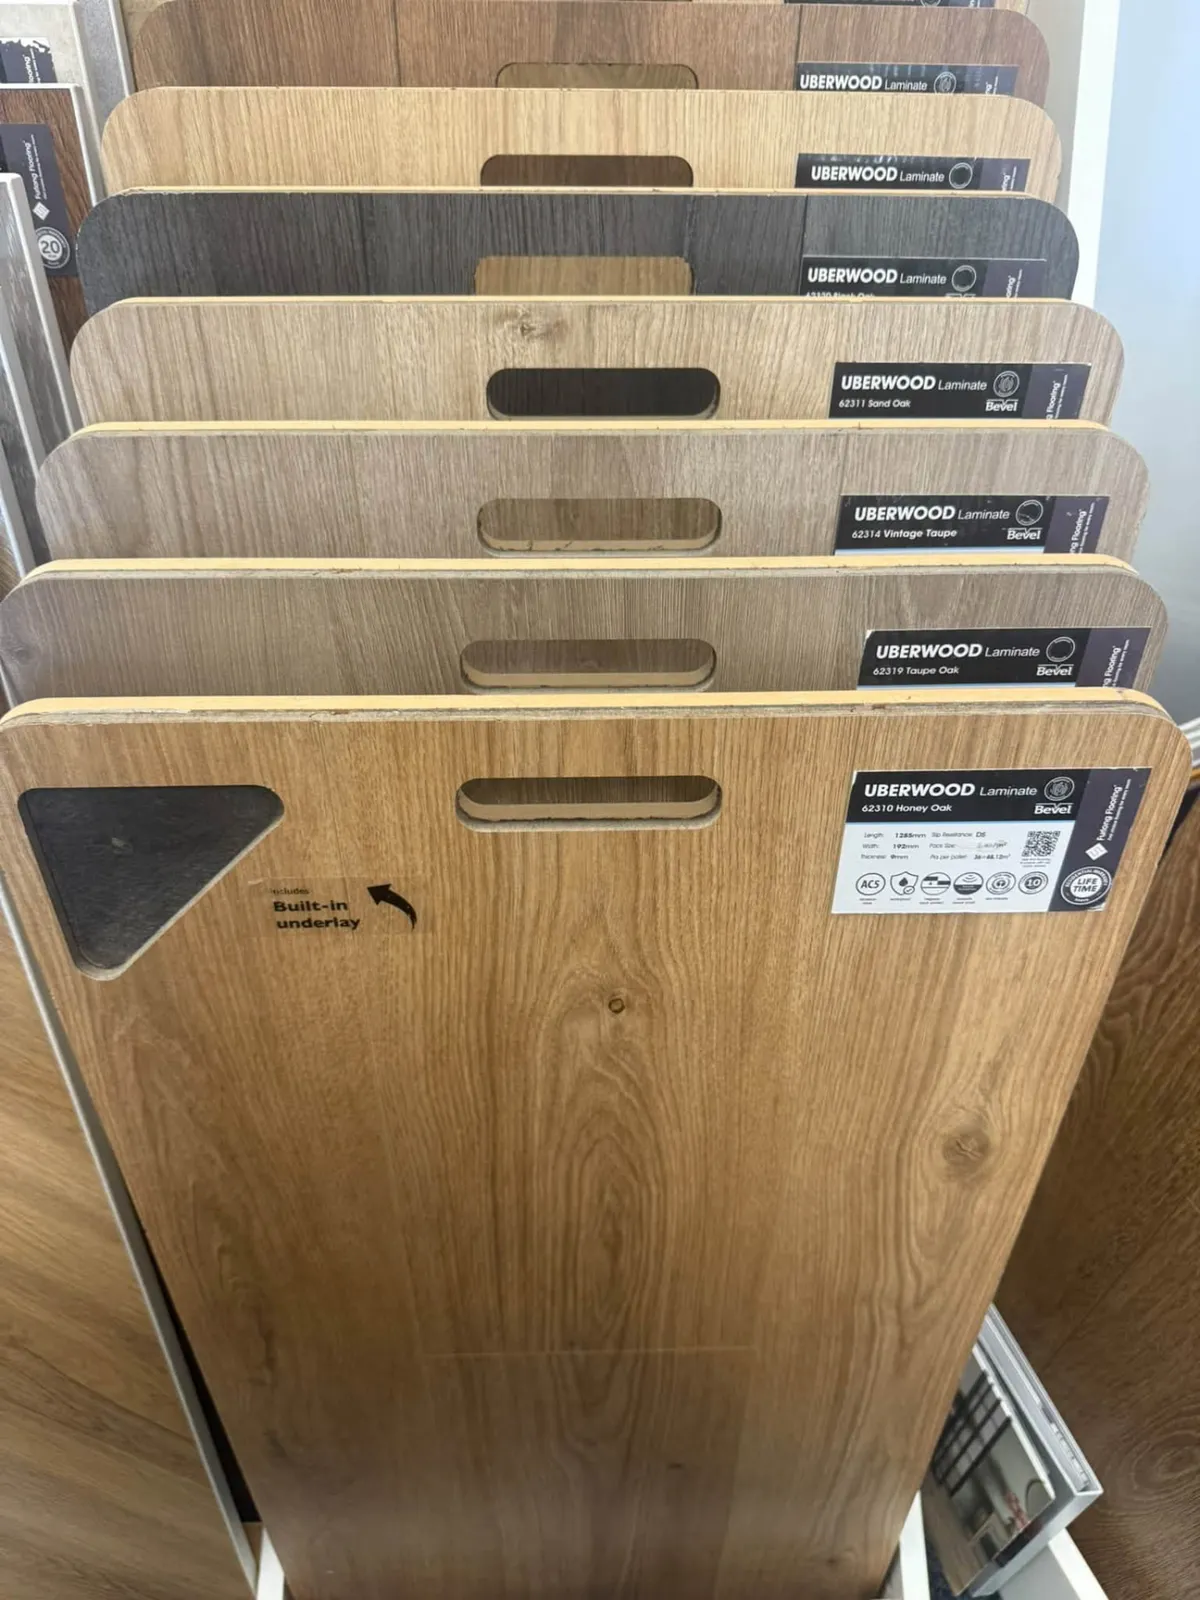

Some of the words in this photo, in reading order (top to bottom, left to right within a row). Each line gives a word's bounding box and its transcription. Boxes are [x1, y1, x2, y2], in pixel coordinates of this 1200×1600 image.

[799, 74, 882, 91] UBERWOOD
[884, 78, 928, 92] Laminate
[811, 165, 898, 182] UBERWOOD
[899, 169, 945, 184] Laminate
[40, 239, 60, 254] 20
[807, 267, 898, 284] UBERWOOD
[899, 272, 947, 286] Laminate
[841, 375, 937, 391] UBERWOOD
[938, 379, 988, 392] Laminate
[838, 398, 866, 409] 62311
[867, 398, 891, 409] Sand
[892, 398, 911, 409] Oak
[985, 399, 1018, 412] Bevel
[854, 505, 956, 521] UBERWOOD
[957, 508, 1010, 521] Laminate
[851, 529, 881, 539] 62314
[883, 528, 923, 540] Vintage
[925, 528, 957, 540] Taupe
[1006, 528, 1041, 541] Bevel
[876, 643, 983, 659] UBERWOOD
[984, 646, 1040, 659] Laminate
[873, 666, 904, 676] 62319
[905, 665, 936, 677] Taupe
[938, 664, 960, 675] Oak
[1036, 664, 1073, 677] Bevel
[864, 782, 976, 798] UBERWOOD
[979, 785, 1038, 797] Laminate
[861, 803, 894, 813] 62310
[895, 803, 929, 814] Honey
[930, 803, 953, 812] Oak
[1034, 803, 1072, 816] Bevel
[860, 879, 880, 889] ACS
[1027, 877, 1040, 887] 10
[1077, 877, 1099, 885] LIFE
[1073, 885, 1098, 893] TIME
[273, 900, 348, 912] Built-in
[277, 917, 361, 930] underlay
